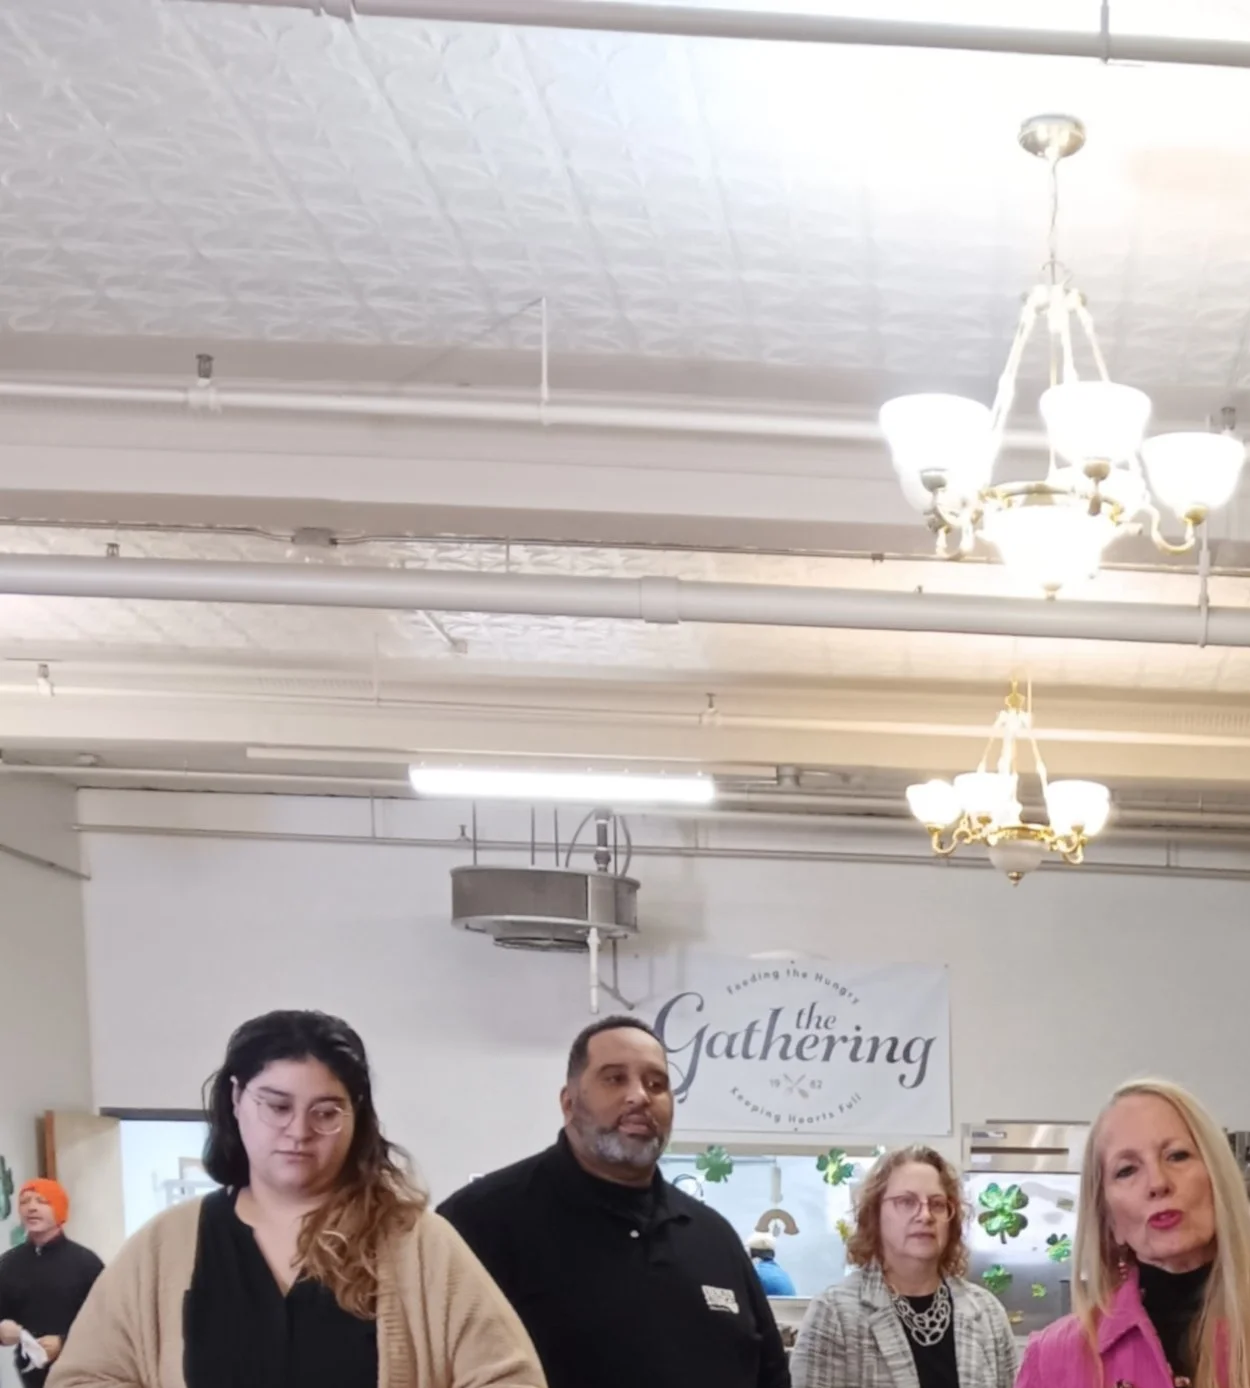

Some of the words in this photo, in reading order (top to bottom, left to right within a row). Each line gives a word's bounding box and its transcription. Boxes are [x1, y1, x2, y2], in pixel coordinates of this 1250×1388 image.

[726, 969, 780, 995] Feeding
[786, 968, 808, 979] the
[814, 972, 860, 1005] Hungry
[795, 1001, 837, 1030] the
[653, 991, 937, 1103] Gathering
[730, 1086, 781, 1124] Keeping
[788, 1111, 835, 1124] Hearts
[838, 1092, 862, 1113] Full
